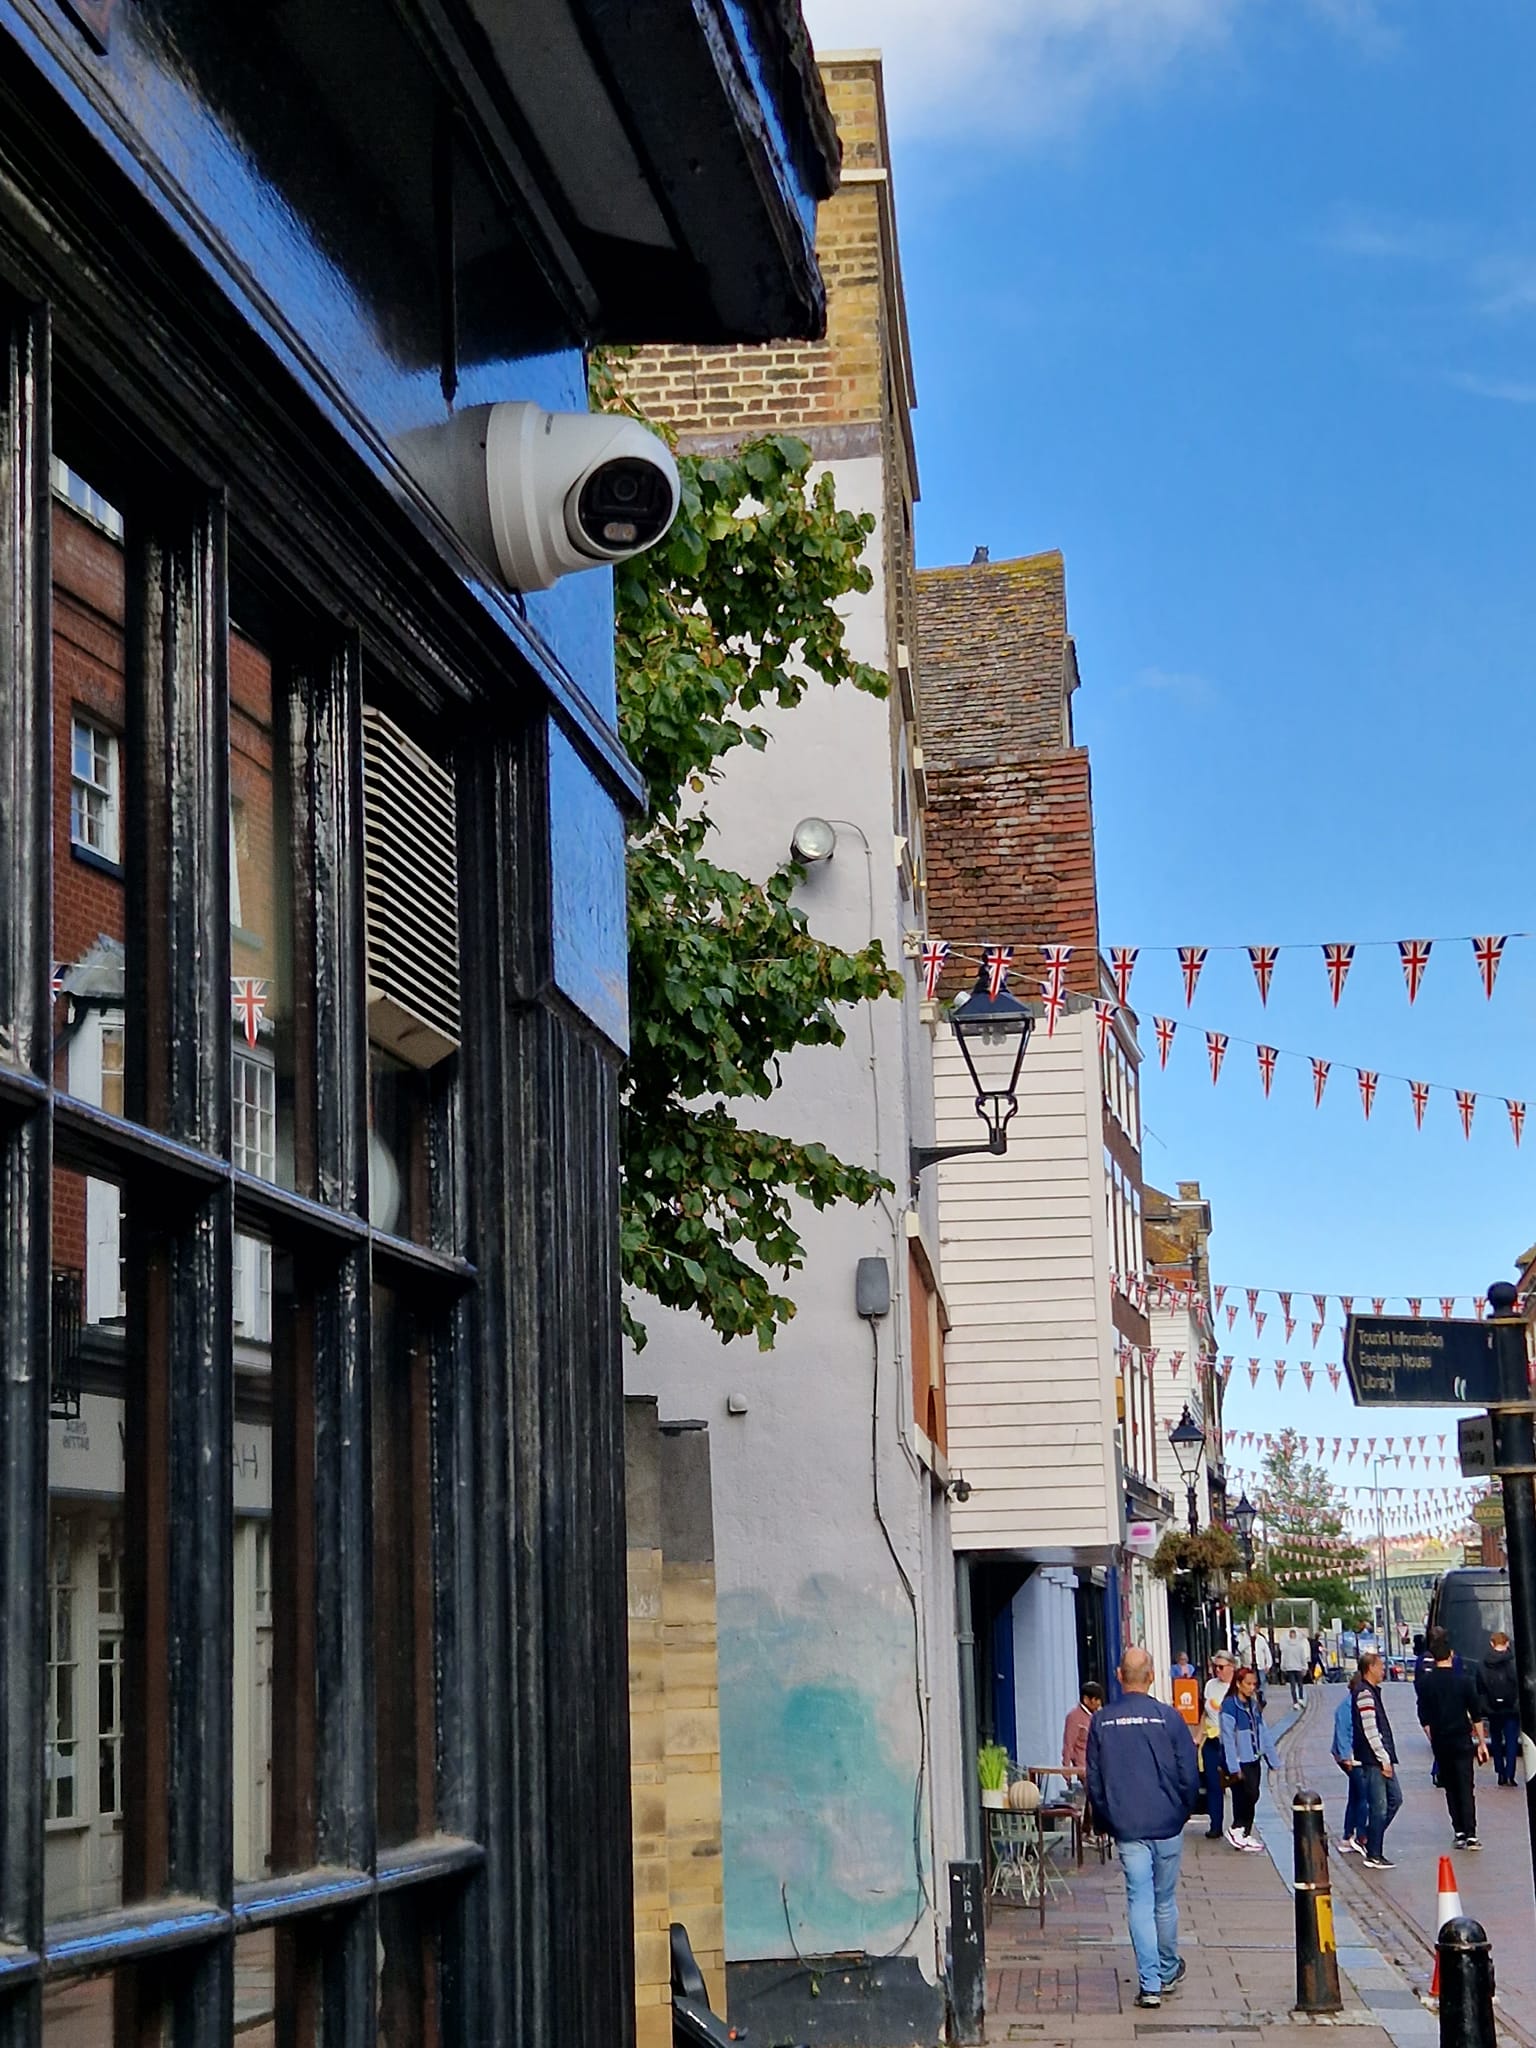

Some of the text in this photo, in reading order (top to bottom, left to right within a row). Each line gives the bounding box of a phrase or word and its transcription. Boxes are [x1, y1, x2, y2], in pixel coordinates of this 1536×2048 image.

[1357, 1329, 1444, 1348] Tourist Information
[1360, 1351, 1432, 1371] Eastgate House
[1361, 1372, 1395, 1392] Library
